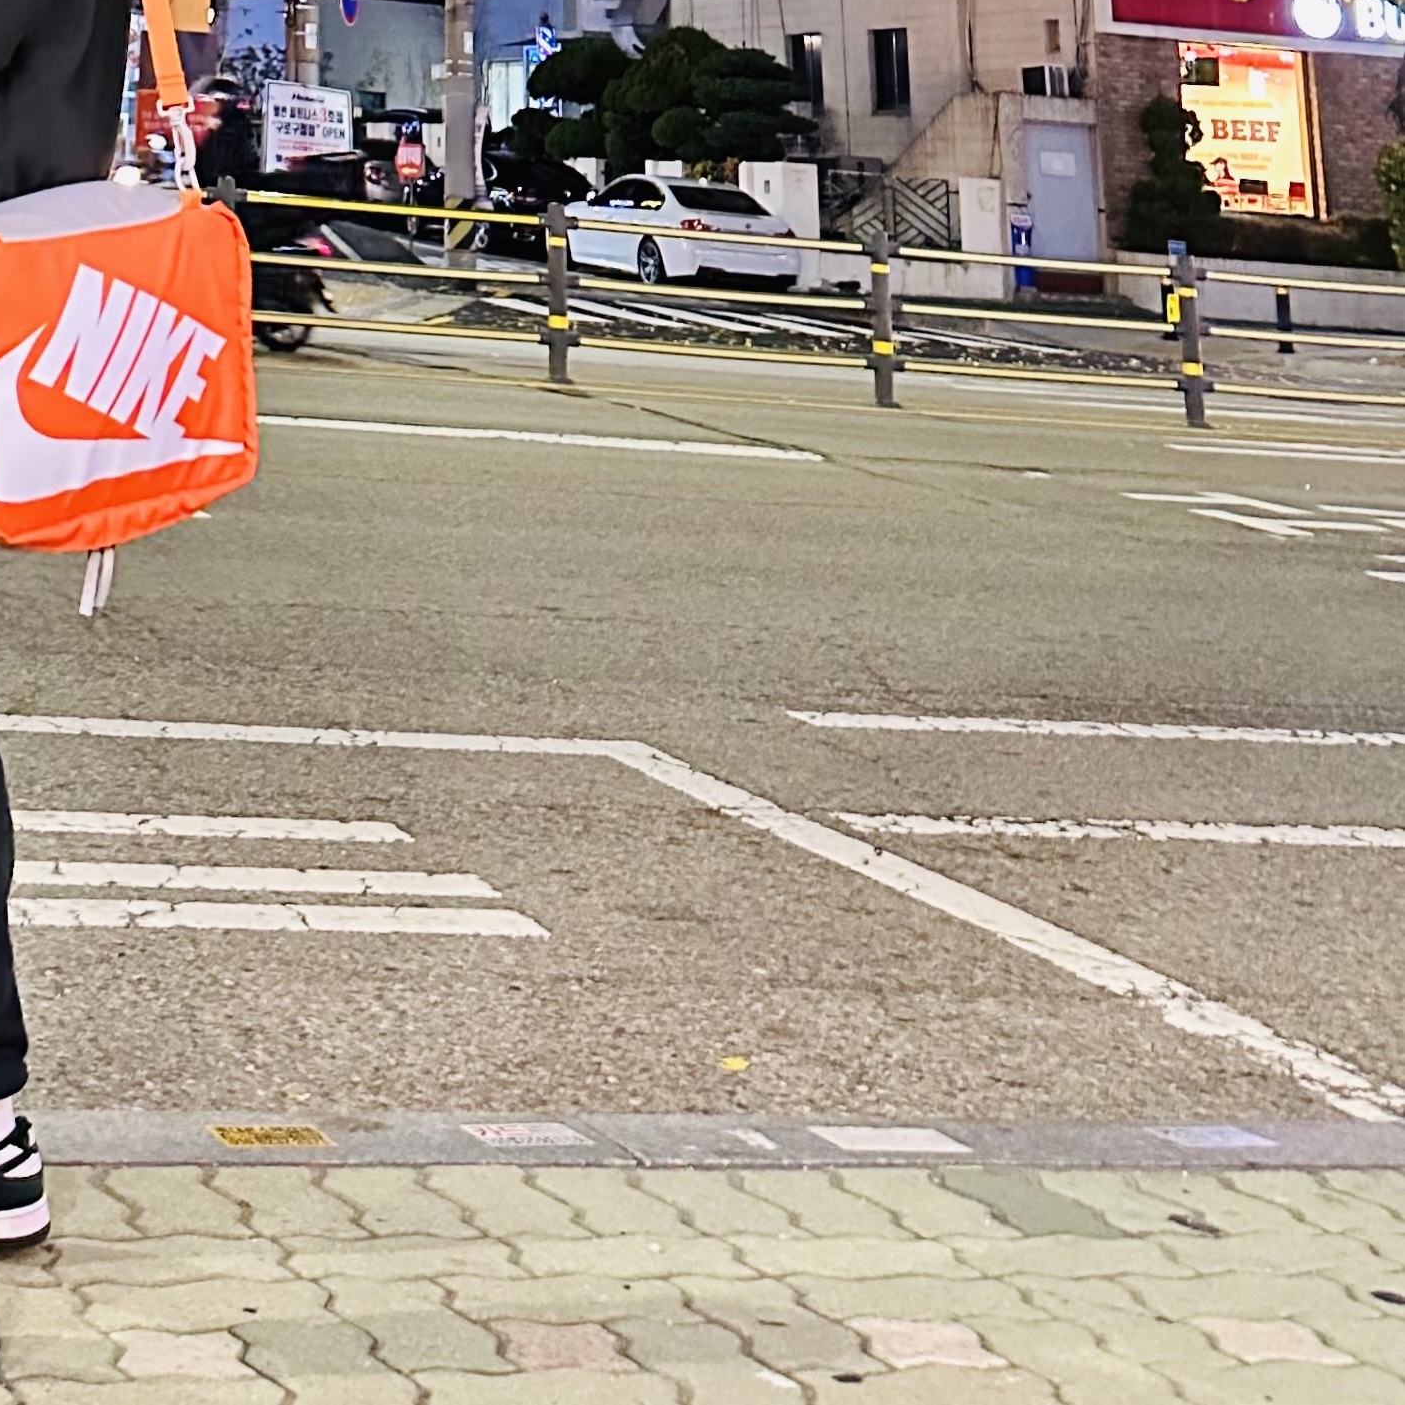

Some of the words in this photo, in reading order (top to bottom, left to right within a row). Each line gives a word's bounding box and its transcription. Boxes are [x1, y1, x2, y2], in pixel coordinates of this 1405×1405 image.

[322, 127, 346, 139] OPEN
[1210, 118, 1282, 143] BEEF
[28, 262, 227, 440] NIKE
